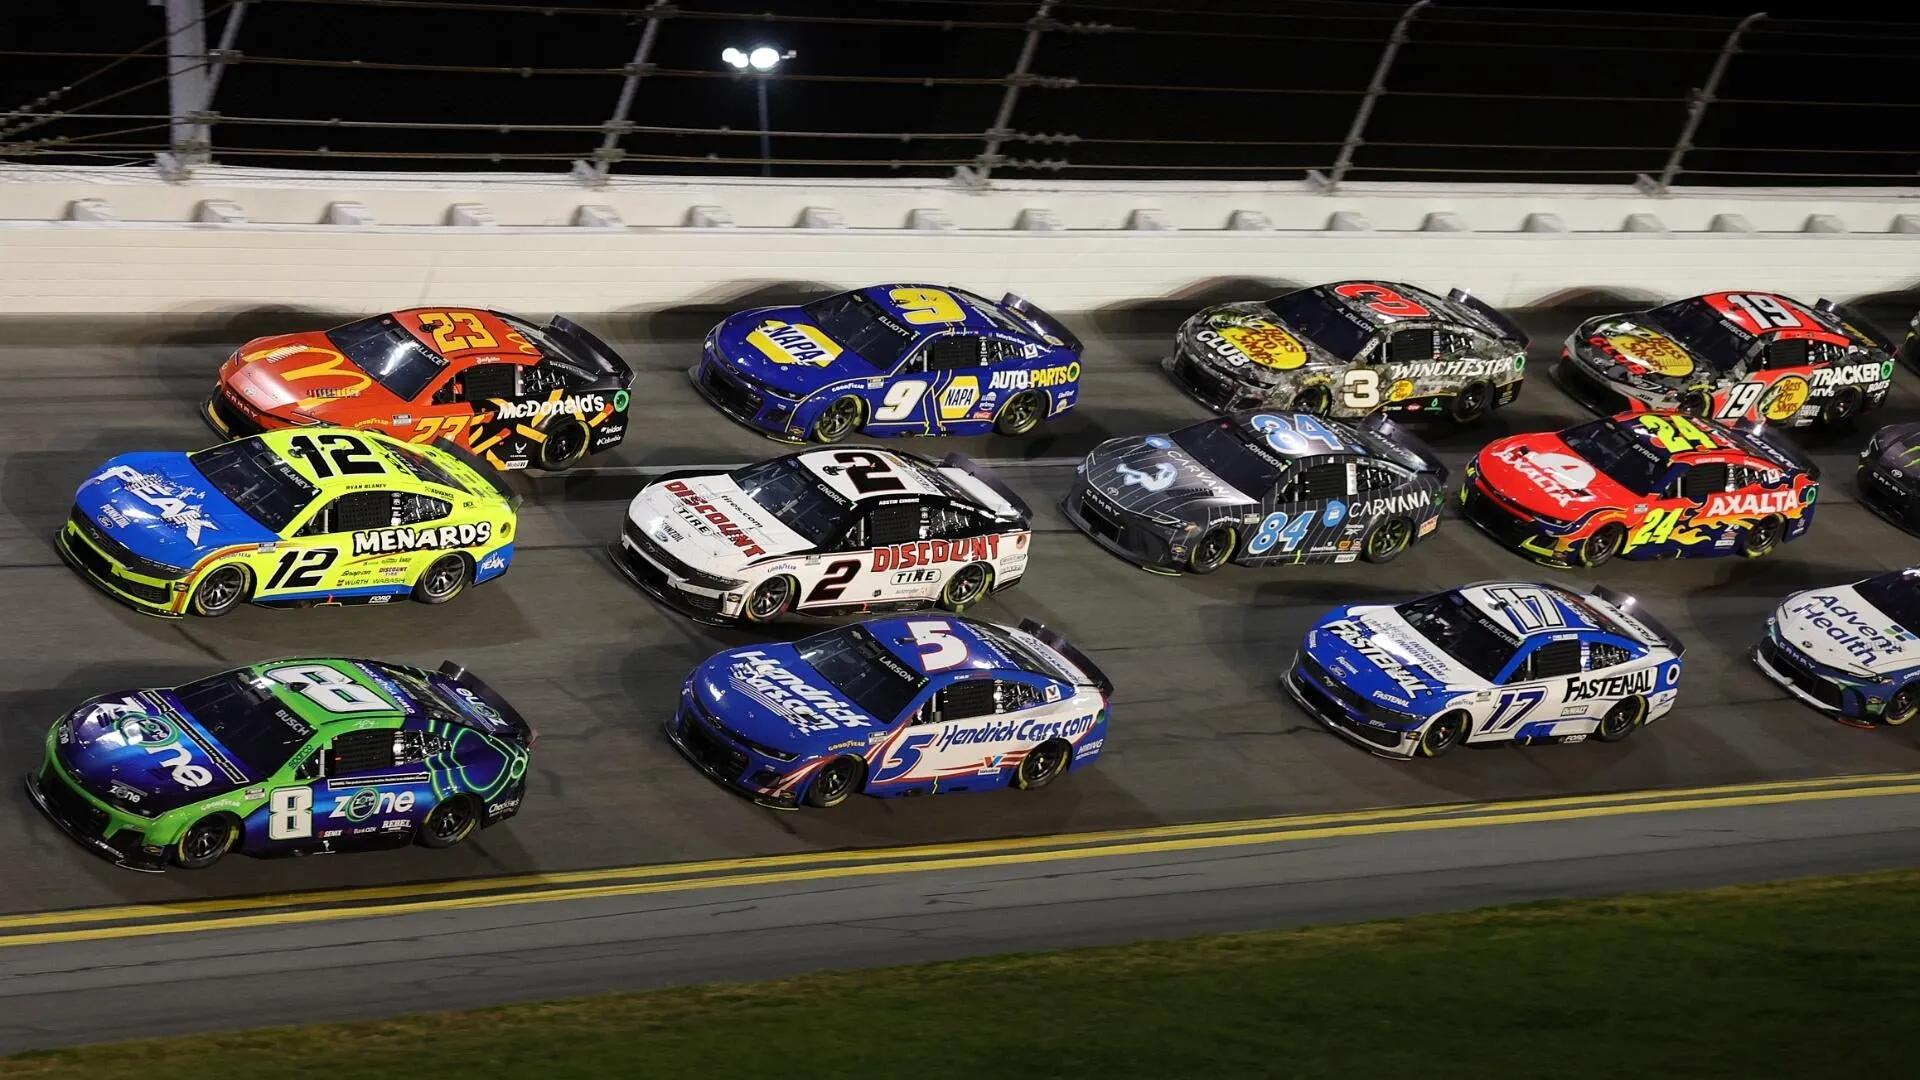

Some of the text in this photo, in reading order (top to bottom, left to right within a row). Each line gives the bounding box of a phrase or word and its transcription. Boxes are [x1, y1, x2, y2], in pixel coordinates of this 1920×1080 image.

[889, 287, 966, 325] 9
[1334, 283, 1431, 317] 3
[1726, 293, 1804, 330] 19
[417, 312, 499, 354] 23
[878, 316, 910, 337] ELLIOTT
[1263, 328, 1300, 353] Bass
[1345, 313, 1374, 333] DILLON
[1719, 318, 1752, 342] BRISCOE
[411, 342, 443, 365] ALLACE
[763, 326, 825, 361] NAPA
[1196, 330, 1250, 367] CLUB
[1232, 334, 1277, 366] Shops
[988, 366, 1068, 390] AUTO PARTS
[1390, 355, 1513, 379] WINCHESTER
[1812, 362, 1881, 387] TRACKER
[832, 383, 864, 393] GOODYEAR
[875, 380, 928, 421] 9
[945, 389, 974, 406] NAPA
[1343, 369, 1380, 408] 3
[1715, 382, 1764, 419] 19
[496, 394, 605, 420] McDonald's
[1251, 414, 1345, 455] 84
[1638, 414, 1718, 453] 24
[290, 433, 387, 480] 12
[1632, 443, 1661, 463] BYRON
[279, 466, 310, 491] BLANEY
[833, 452, 907, 494] 2
[95, 465, 219, 546] PEAK
[817, 483, 847, 506] CINDRIC
[1086, 488, 1121, 516] CAMRY
[1348, 490, 1431, 518] CARVANA
[1707, 489, 1798, 517] AXALTA
[664, 481, 766, 558] DISCOUNT
[678, 506, 710, 533] TIRE
[1247, 510, 1317, 554] 84
[1631, 507, 1685, 545] 24
[353, 521, 492, 557] MENARDS
[870, 533, 1000, 573] DISCOUNT
[264, 547, 341, 590] 12
[480, 556, 505, 574] PEAK
[803, 559, 862, 603] 2
[1483, 587, 1567, 632] 17
[1811, 594, 1903, 655] Advent
[906, 620, 969, 673] 5
[1791, 603, 1878, 667] Health
[879, 655, 915, 683] LARSON
[1779, 641, 1816, 669] CAMRY
[263, 664, 397, 714] 8
[729, 650, 873, 728] Hendrick
[1561, 669, 1652, 703] FASTENAL
[275, 709, 309, 736] BUSCH
[1474, 685, 1549, 736] 17
[828, 740, 866, 752] GOODYEAR
[871, 732, 939, 784] 5
[107, 785, 141, 804] zone
[328, 786, 415, 822] zone
[268, 785, 314, 841] 8
[381, 820, 412, 829] REBEL
